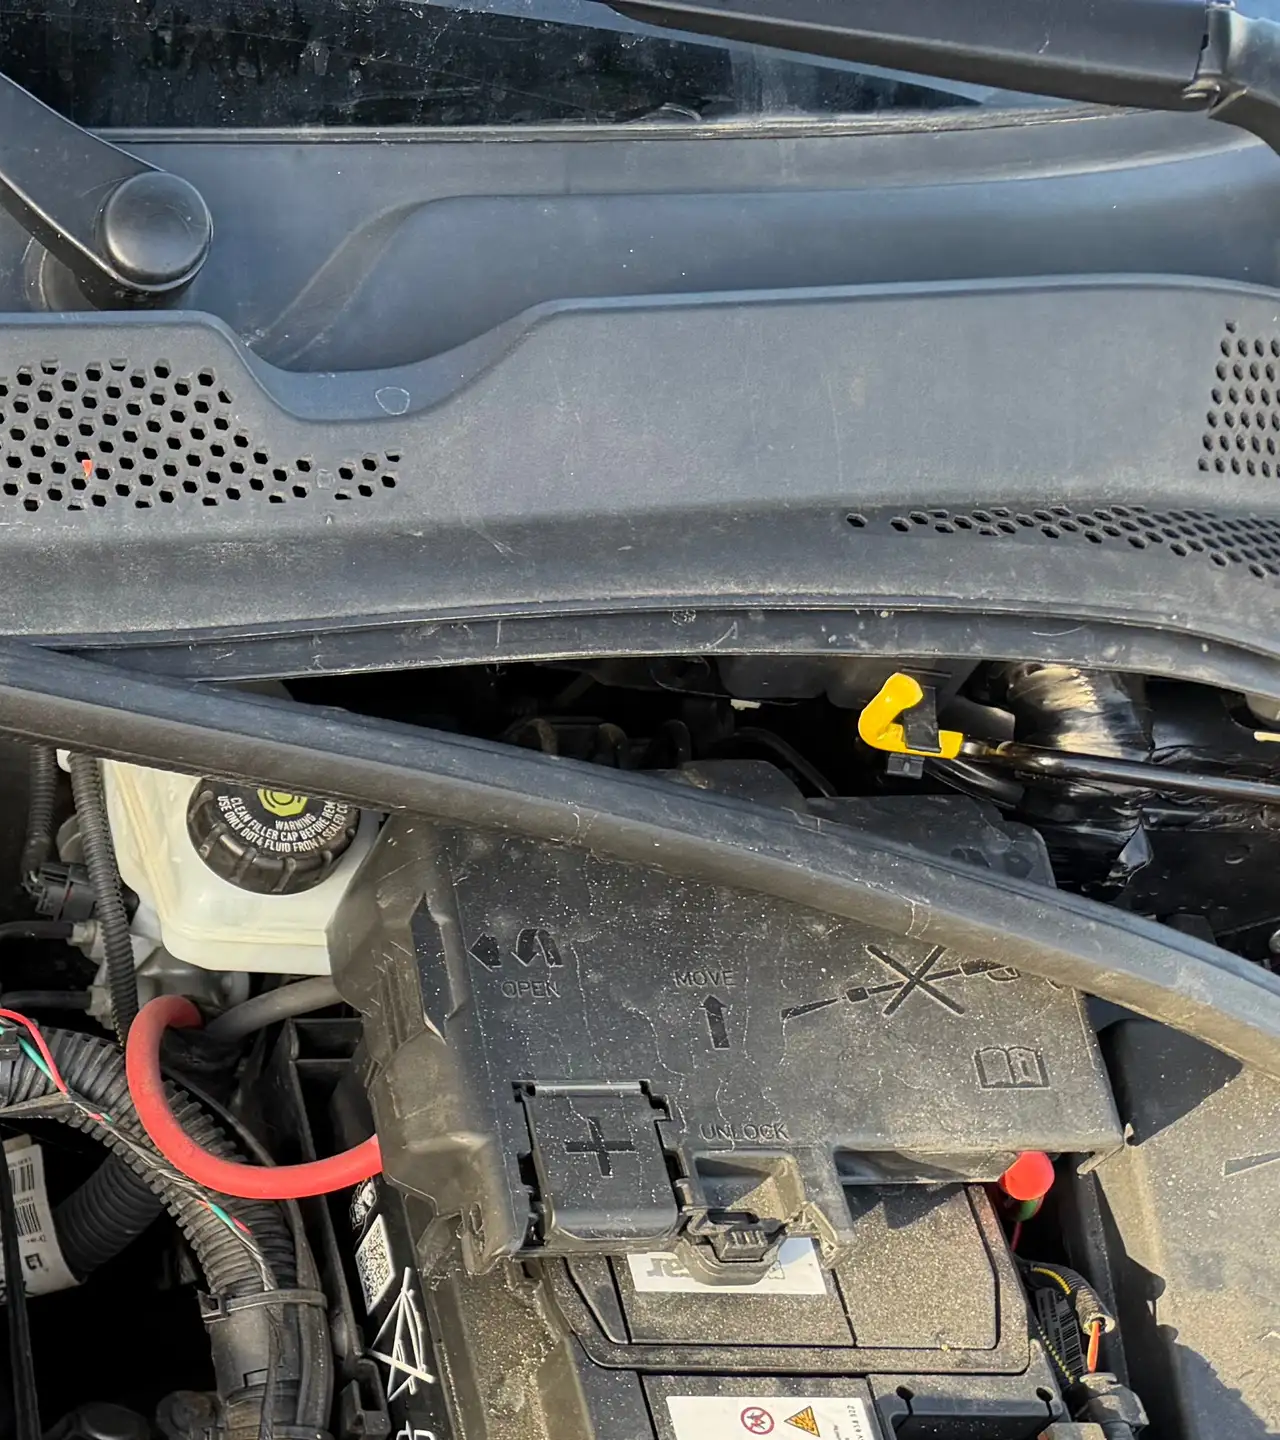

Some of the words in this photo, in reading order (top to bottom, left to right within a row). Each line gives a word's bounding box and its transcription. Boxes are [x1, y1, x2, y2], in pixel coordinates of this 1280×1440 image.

[217, 795, 230, 812] USE
[224, 811, 244, 830] ONLY
[264, 840, 293, 853] FLUID
[292, 838, 318, 852] FROM
[322, 814, 346, 840] SEALED
[231, 797, 252, 823] CLEAN
[248, 819, 279, 840] FILLER
[281, 832, 299, 841] CAP
[299, 816, 330, 840] BEFORE
[275, 813, 316, 831] WARNING
[674, 971, 737, 987] MOVE
[500, 980, 561, 998] OPEN
[699, 1122, 790, 1141] UNLOCK
